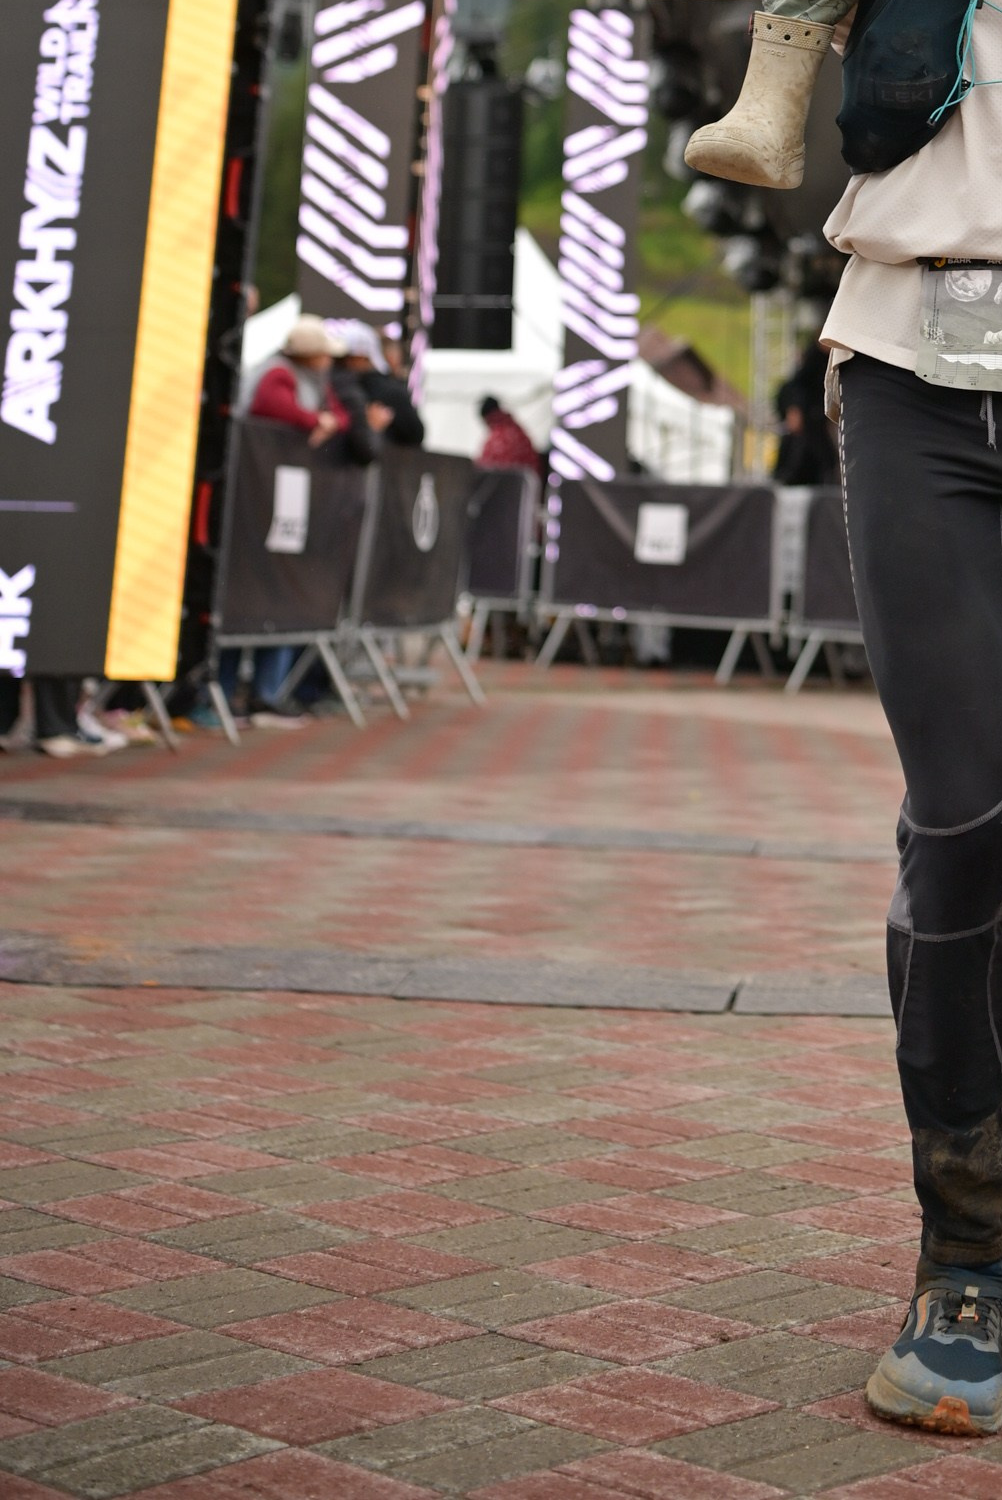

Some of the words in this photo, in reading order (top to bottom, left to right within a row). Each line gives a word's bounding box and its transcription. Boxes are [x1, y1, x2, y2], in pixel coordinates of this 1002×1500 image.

[32, 27, 68, 125] WILD
[0, 125, 88, 445] ARKHYZ
[0, 563, 37, 678] НК
